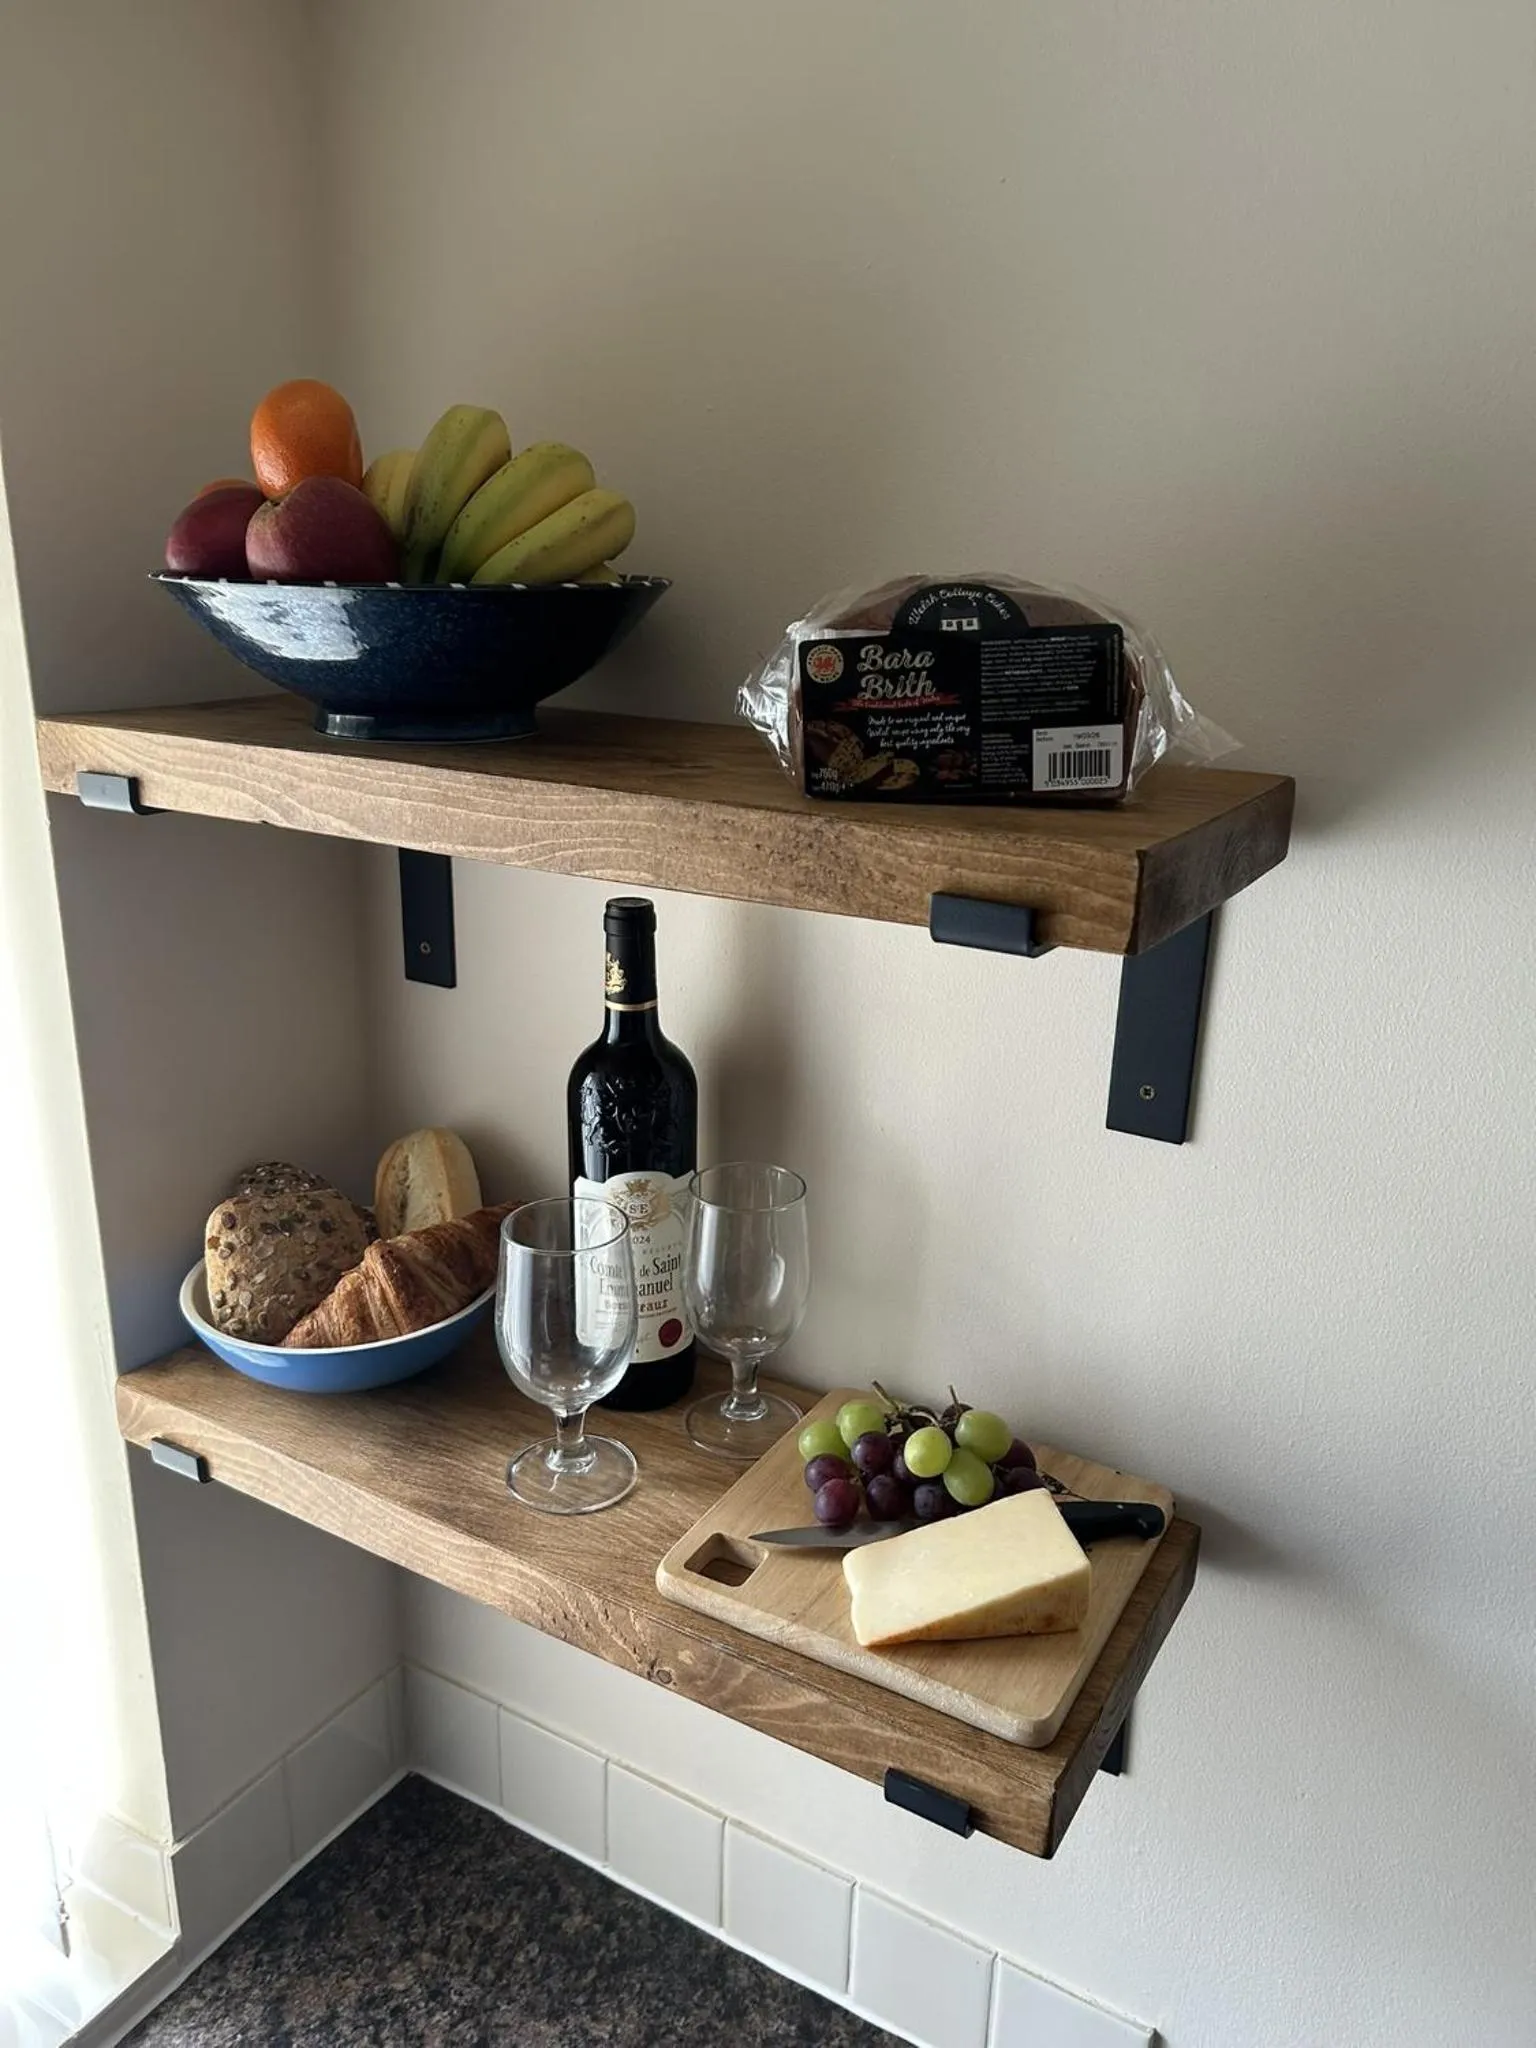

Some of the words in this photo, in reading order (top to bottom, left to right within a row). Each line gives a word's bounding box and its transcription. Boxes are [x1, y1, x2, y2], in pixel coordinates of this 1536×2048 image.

[908, 593, 940, 625] Welsh
[939, 588, 982, 600] Cottage
[985, 592, 1012, 620] Cakes
[857, 644, 935, 672] Bara
[857, 671, 937, 700] Brith
[904, 712, 931, 727] original
[931, 712, 945, 721] and
[945, 722, 955, 732] the
[956, 725, 970, 736] very
[880, 737, 894, 748] best
[895, 736, 918, 750] quality
[919, 733, 955, 749] ingredients
[633, 1235, 651, 1244] 024
[640, 1264, 651, 1277] de
[652, 1254, 681, 1276] Saint
